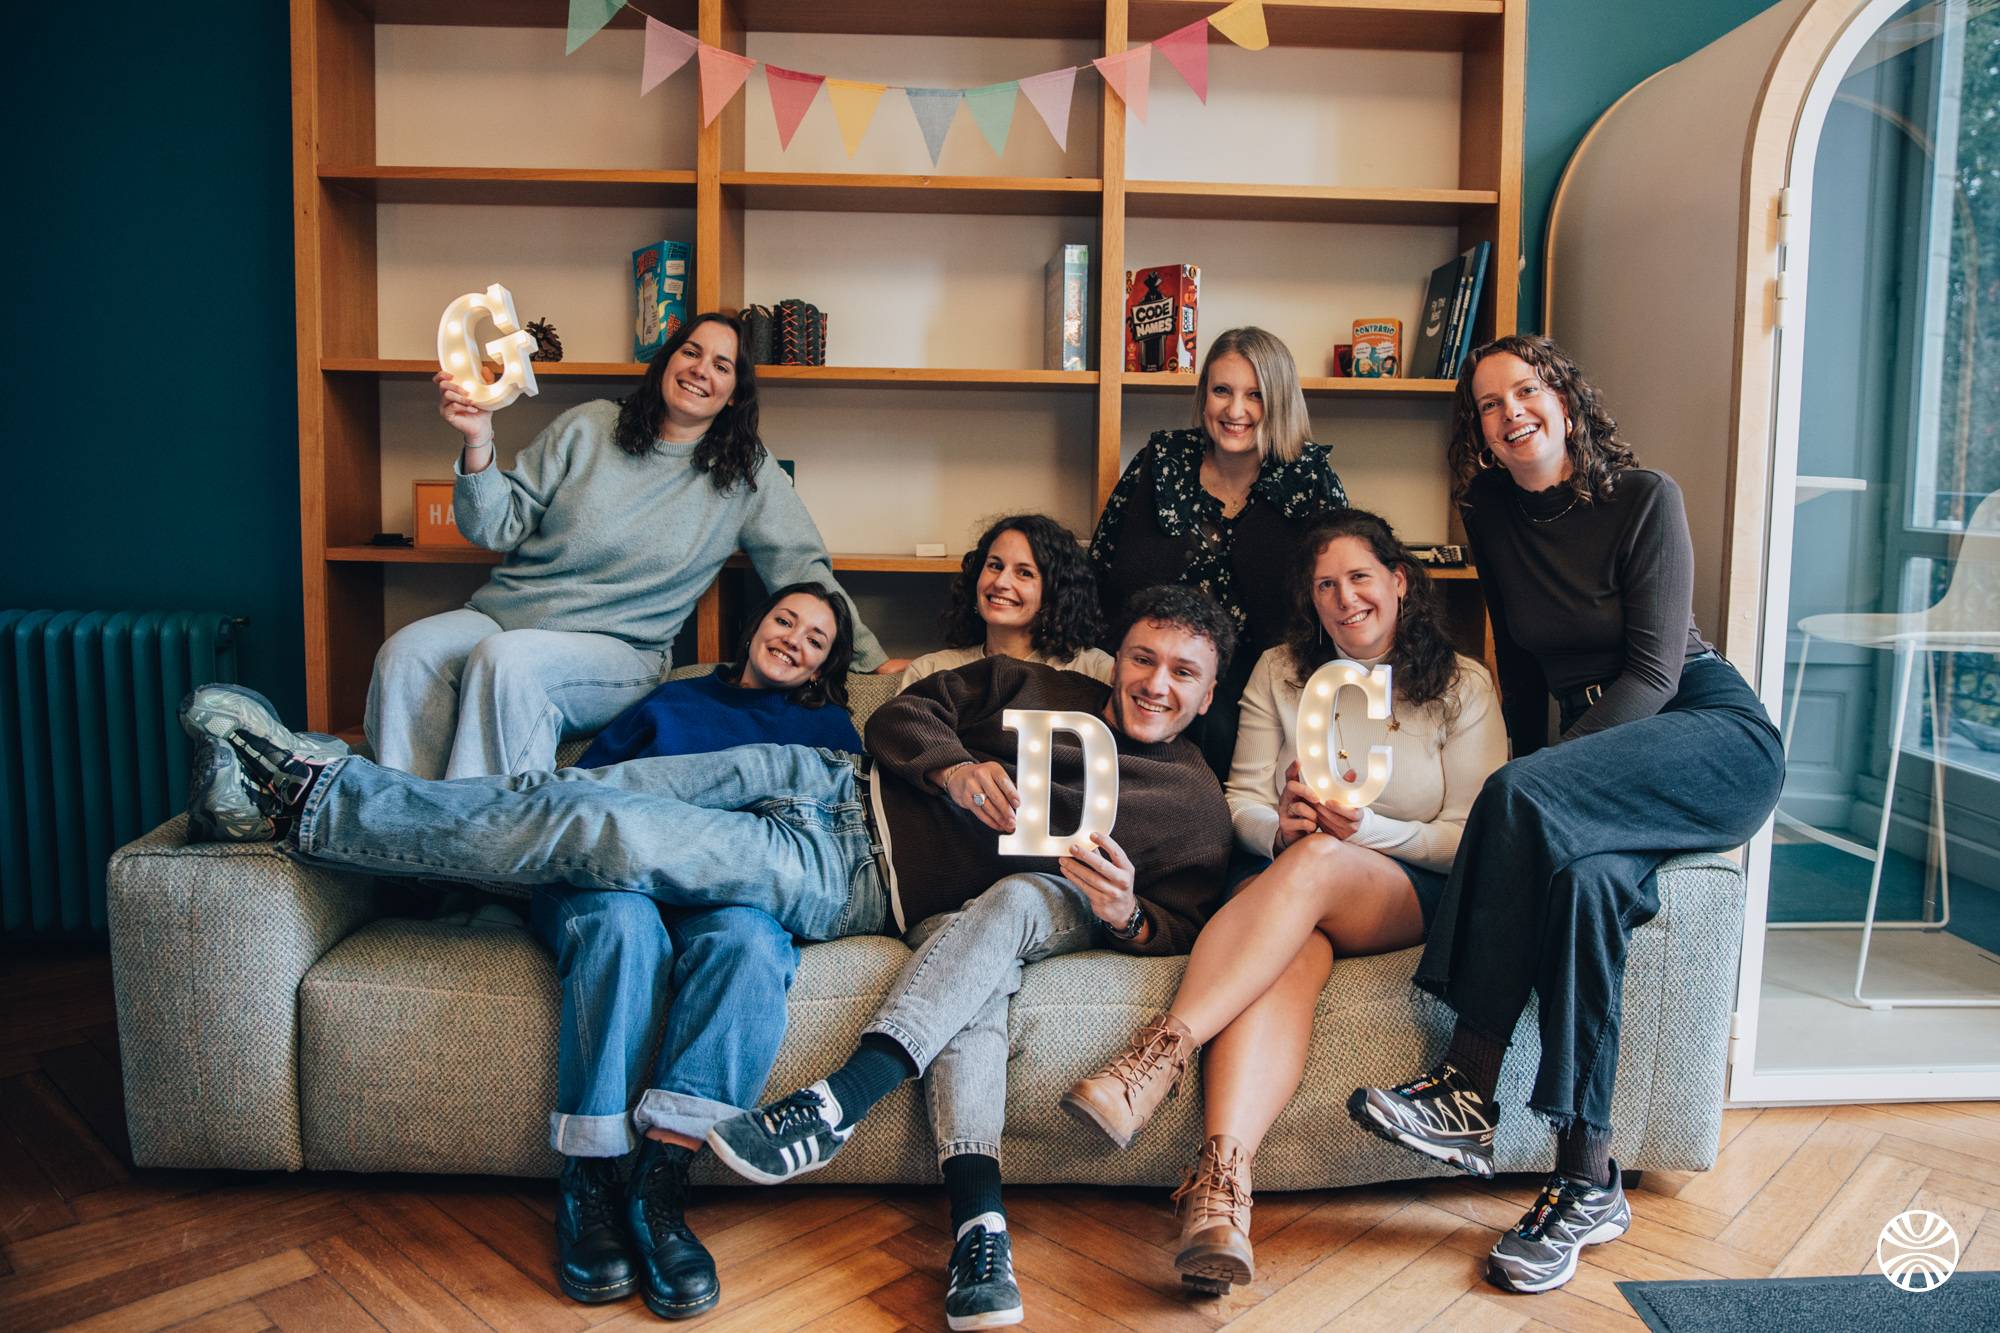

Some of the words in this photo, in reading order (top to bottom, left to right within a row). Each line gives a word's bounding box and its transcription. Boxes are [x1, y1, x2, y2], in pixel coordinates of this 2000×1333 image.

[437, 283, 539, 411] G
[1135, 318, 1173, 337] NAMES
[1136, 302, 1170, 322] CODE
[430, 504, 456, 525] HA
[1296, 659, 1392, 808] C
[998, 709, 1119, 856] D
